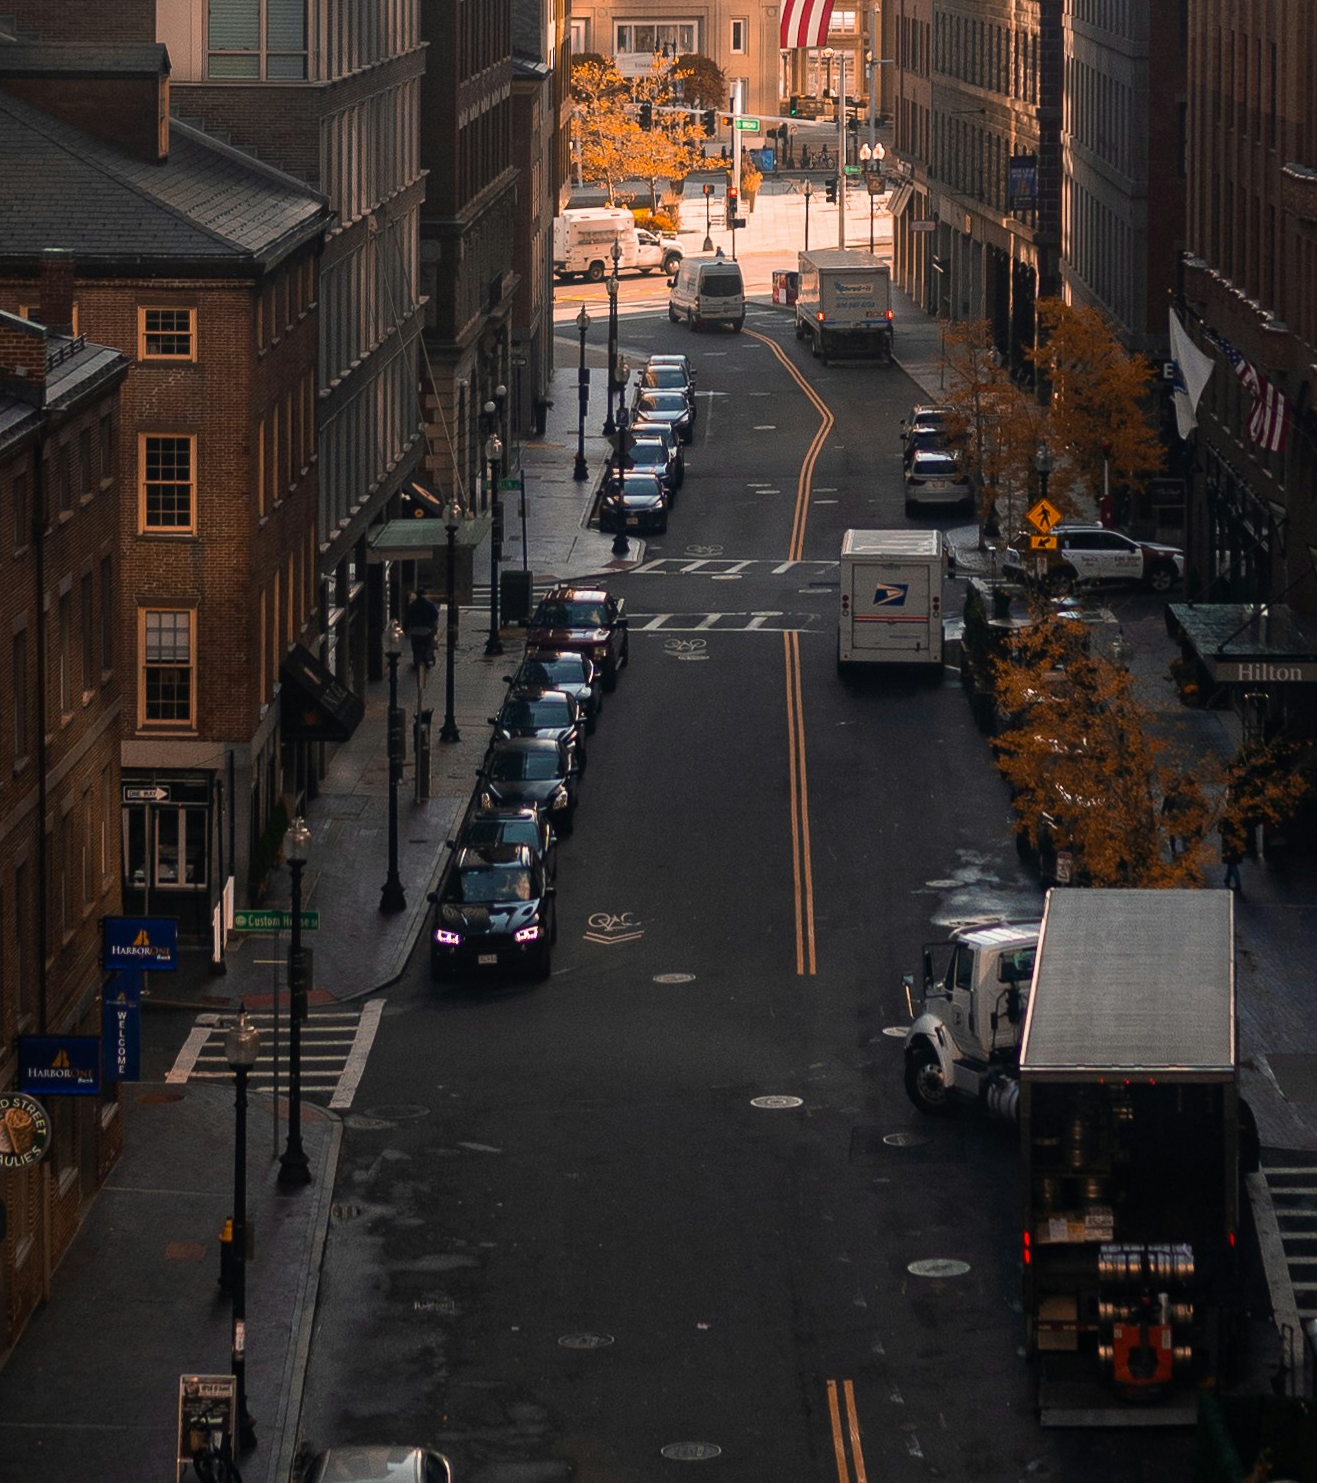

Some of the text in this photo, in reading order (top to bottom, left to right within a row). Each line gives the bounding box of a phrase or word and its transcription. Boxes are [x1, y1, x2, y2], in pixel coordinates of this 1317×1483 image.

[1238, 663, 1302, 681] Hilton
[248, 914, 280, 927] Custom
[117, 1011, 127, 1074] WELCOME
[12, 1098, 47, 1136] STREET
